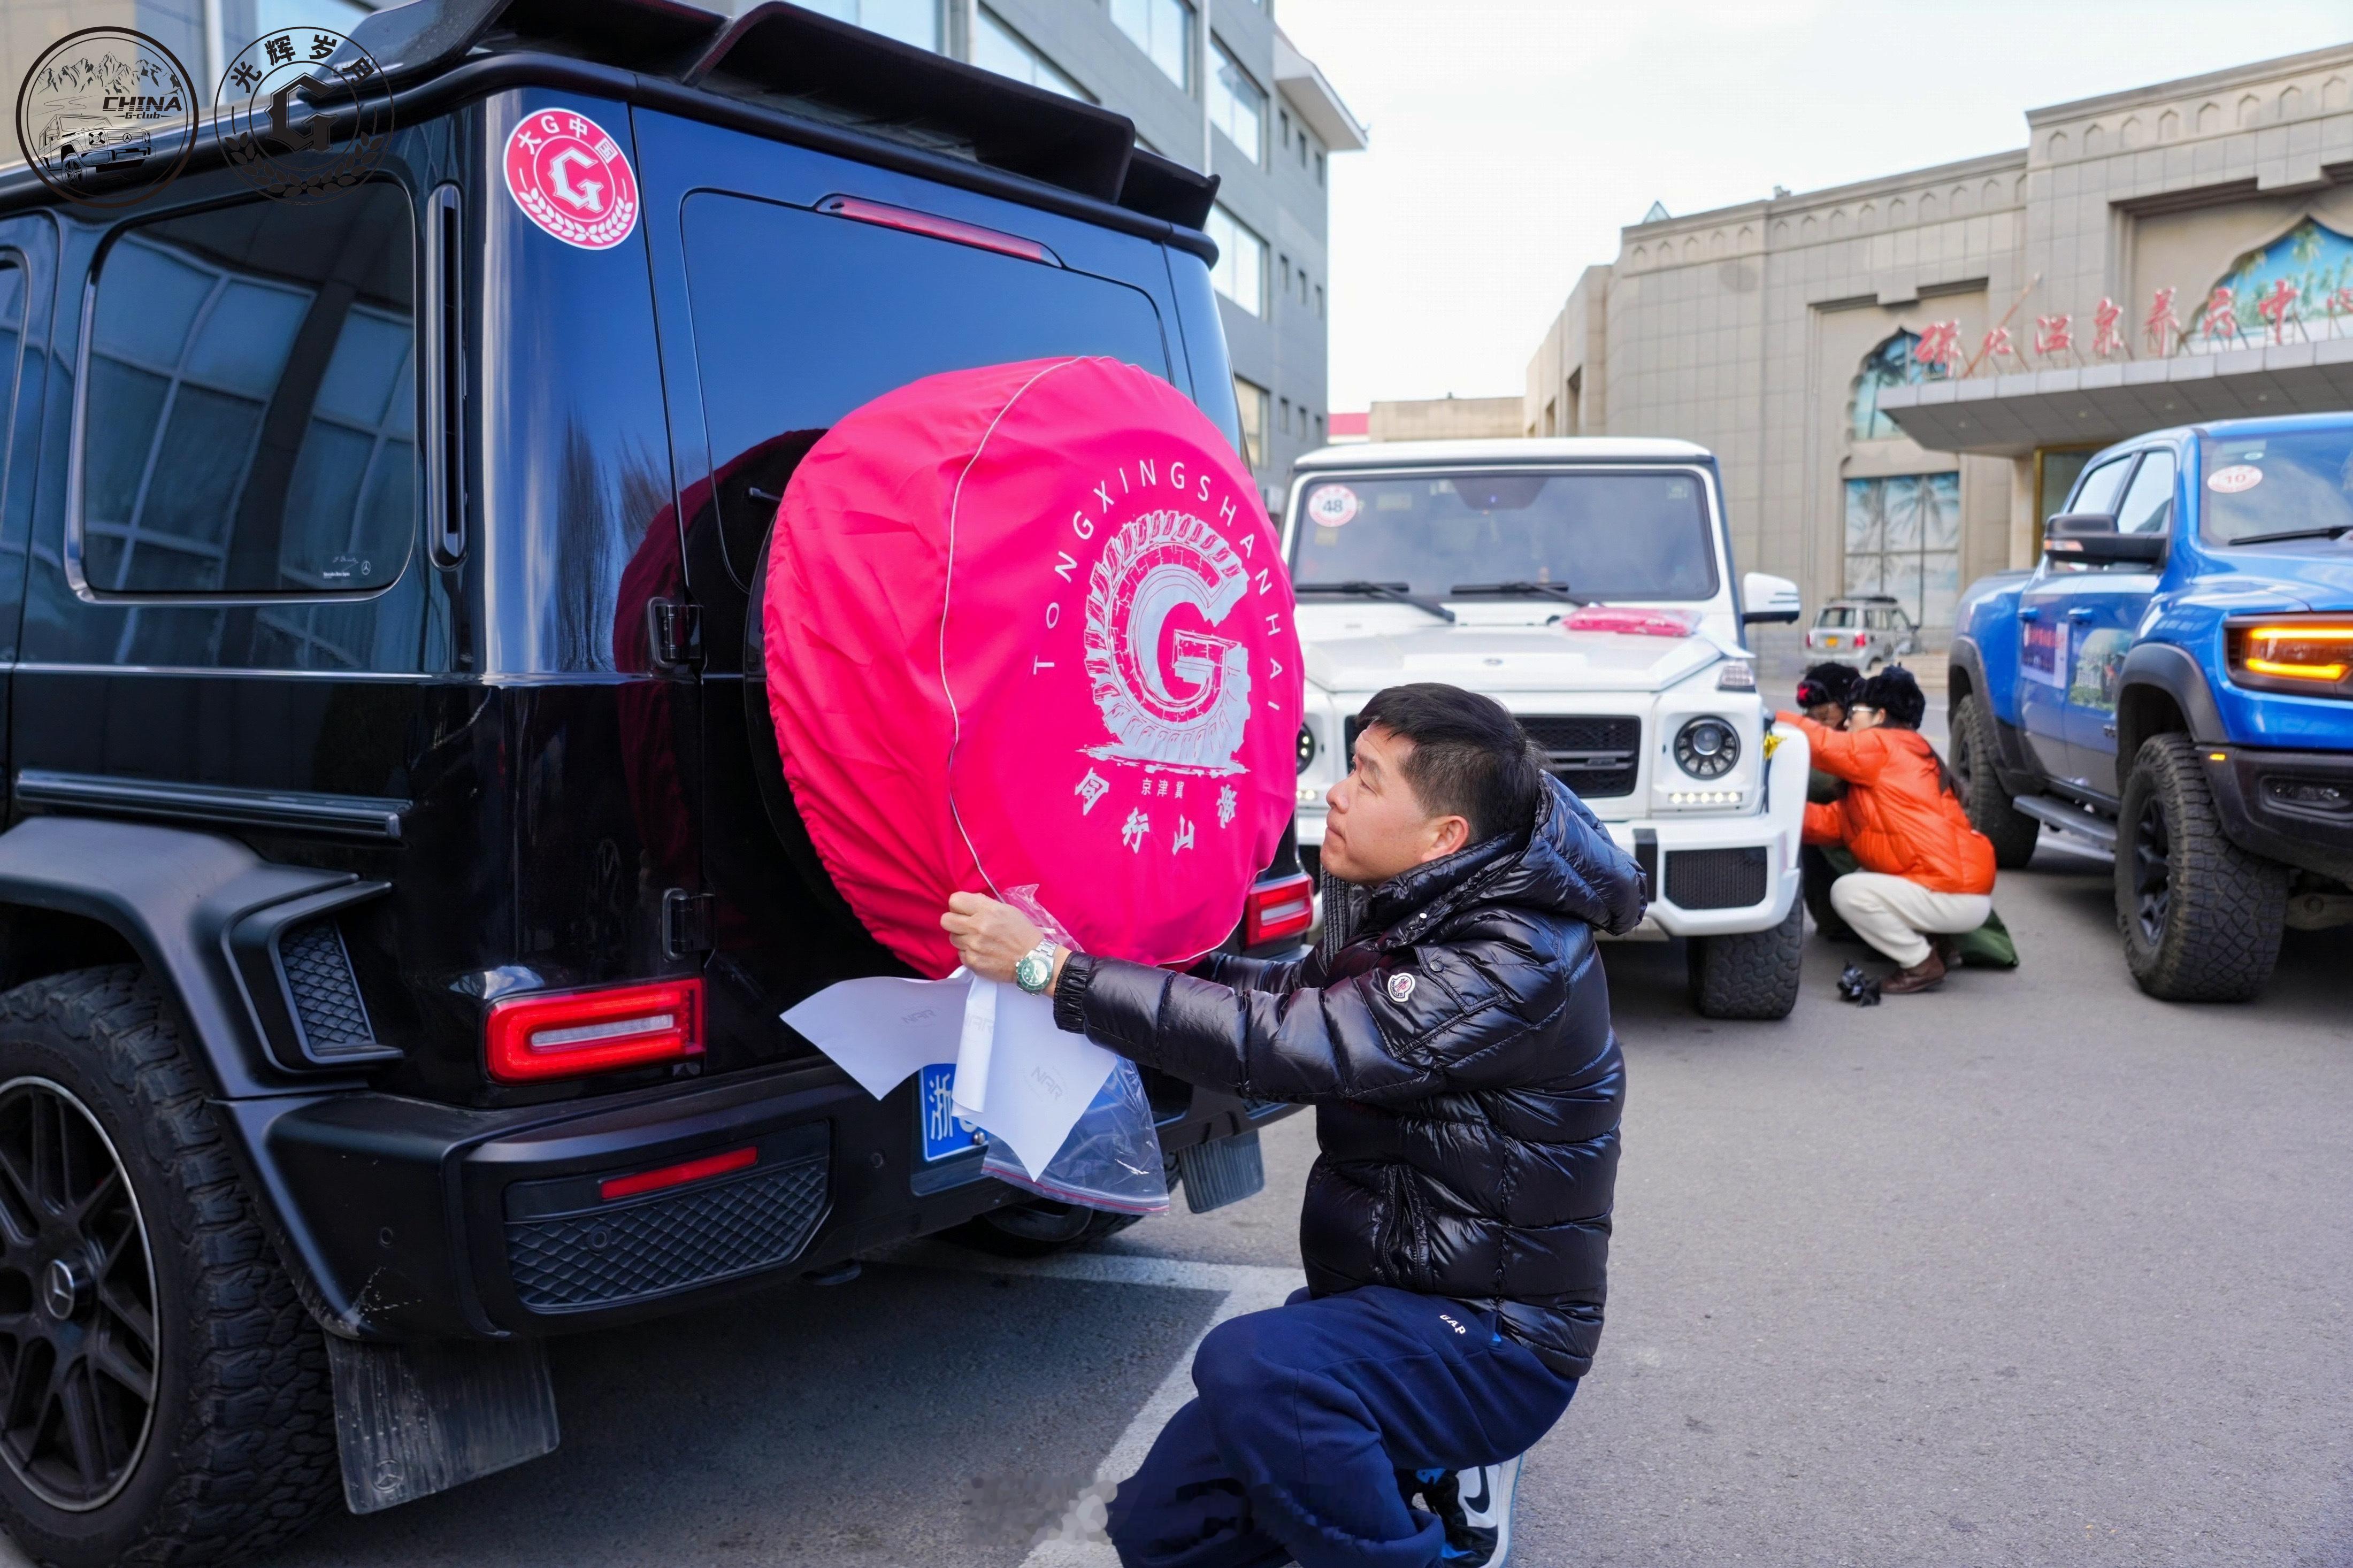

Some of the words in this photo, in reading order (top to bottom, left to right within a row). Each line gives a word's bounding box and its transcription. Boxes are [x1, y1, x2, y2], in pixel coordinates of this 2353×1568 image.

[517, 114, 618, 164] 大G中国
[1323, 499, 1343, 512] 48
[1141, 777, 1185, 799] 京津冀
[1075, 767, 1238, 855] 同行山海
[1440, 1315, 1466, 1334] GAP
